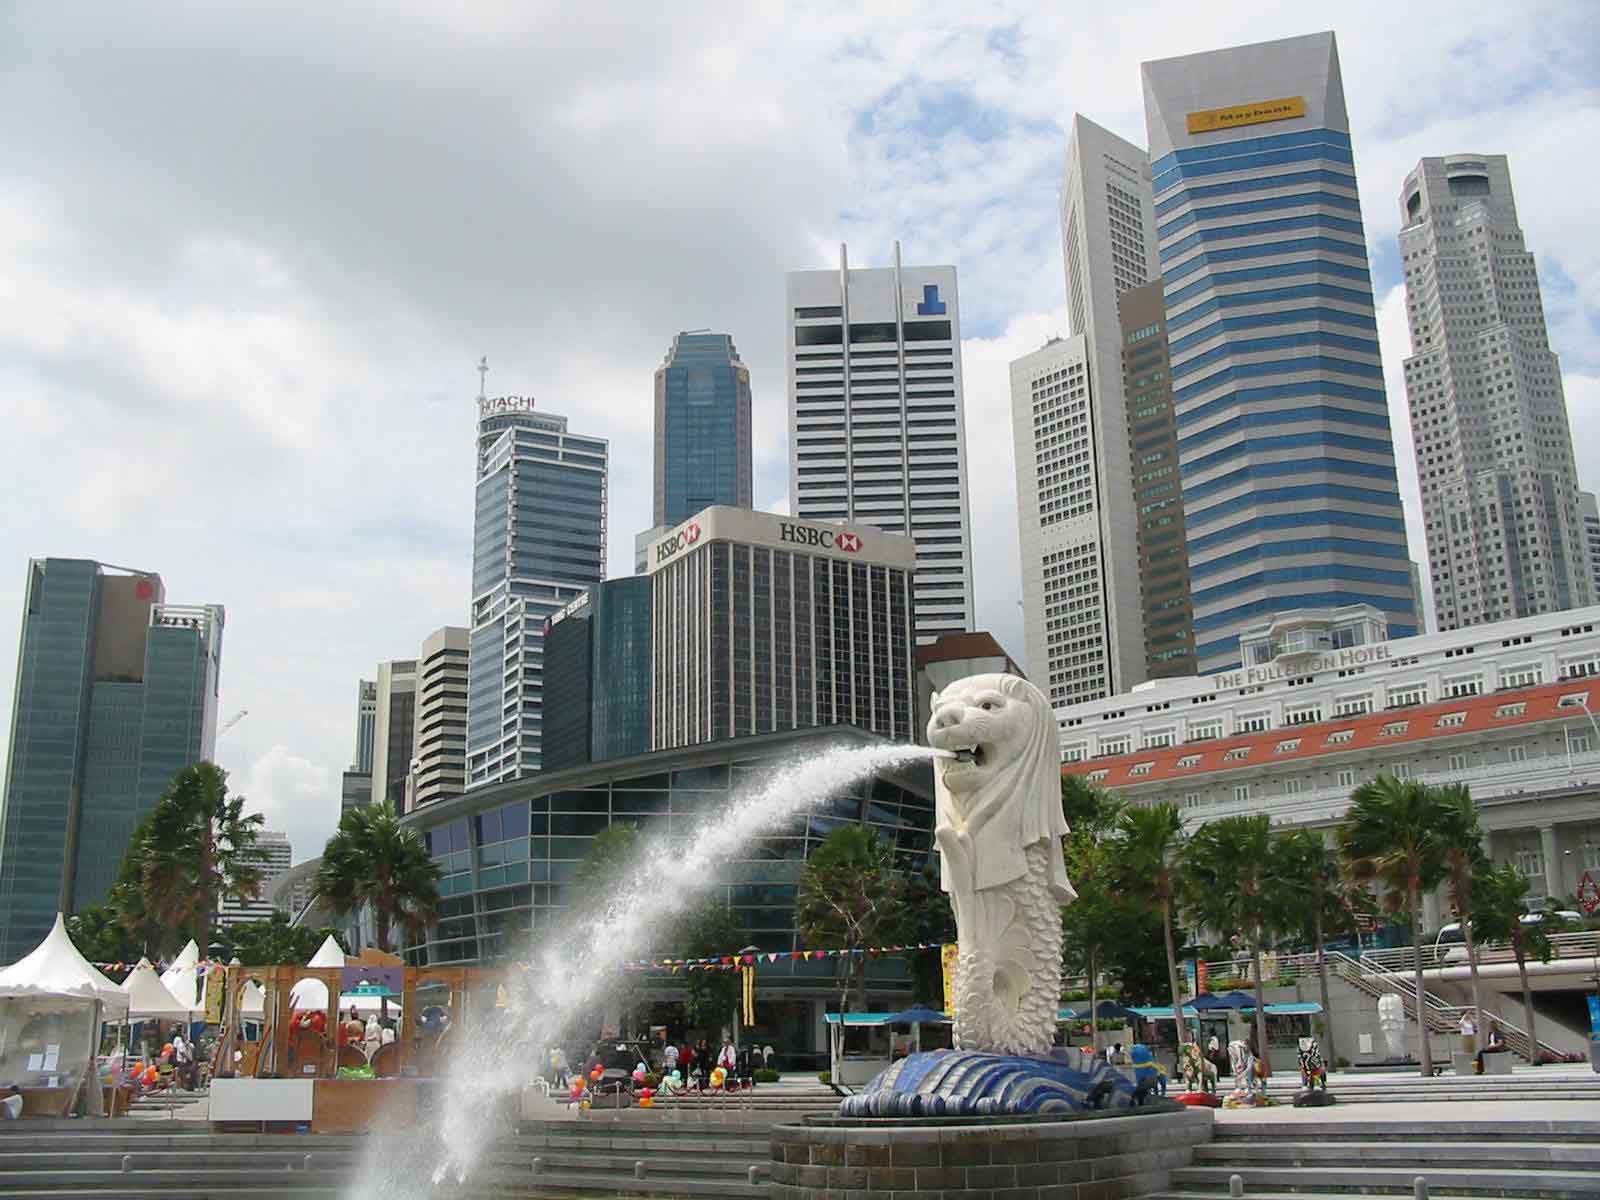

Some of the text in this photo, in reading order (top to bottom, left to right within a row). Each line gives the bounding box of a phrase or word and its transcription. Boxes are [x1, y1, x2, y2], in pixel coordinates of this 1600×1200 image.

[656, 531, 686, 562] HSBC
[780, 523, 833, 548] HSBC
[1214, 673, 1242, 690] THE
[1338, 645, 1393, 665] HOTEL
